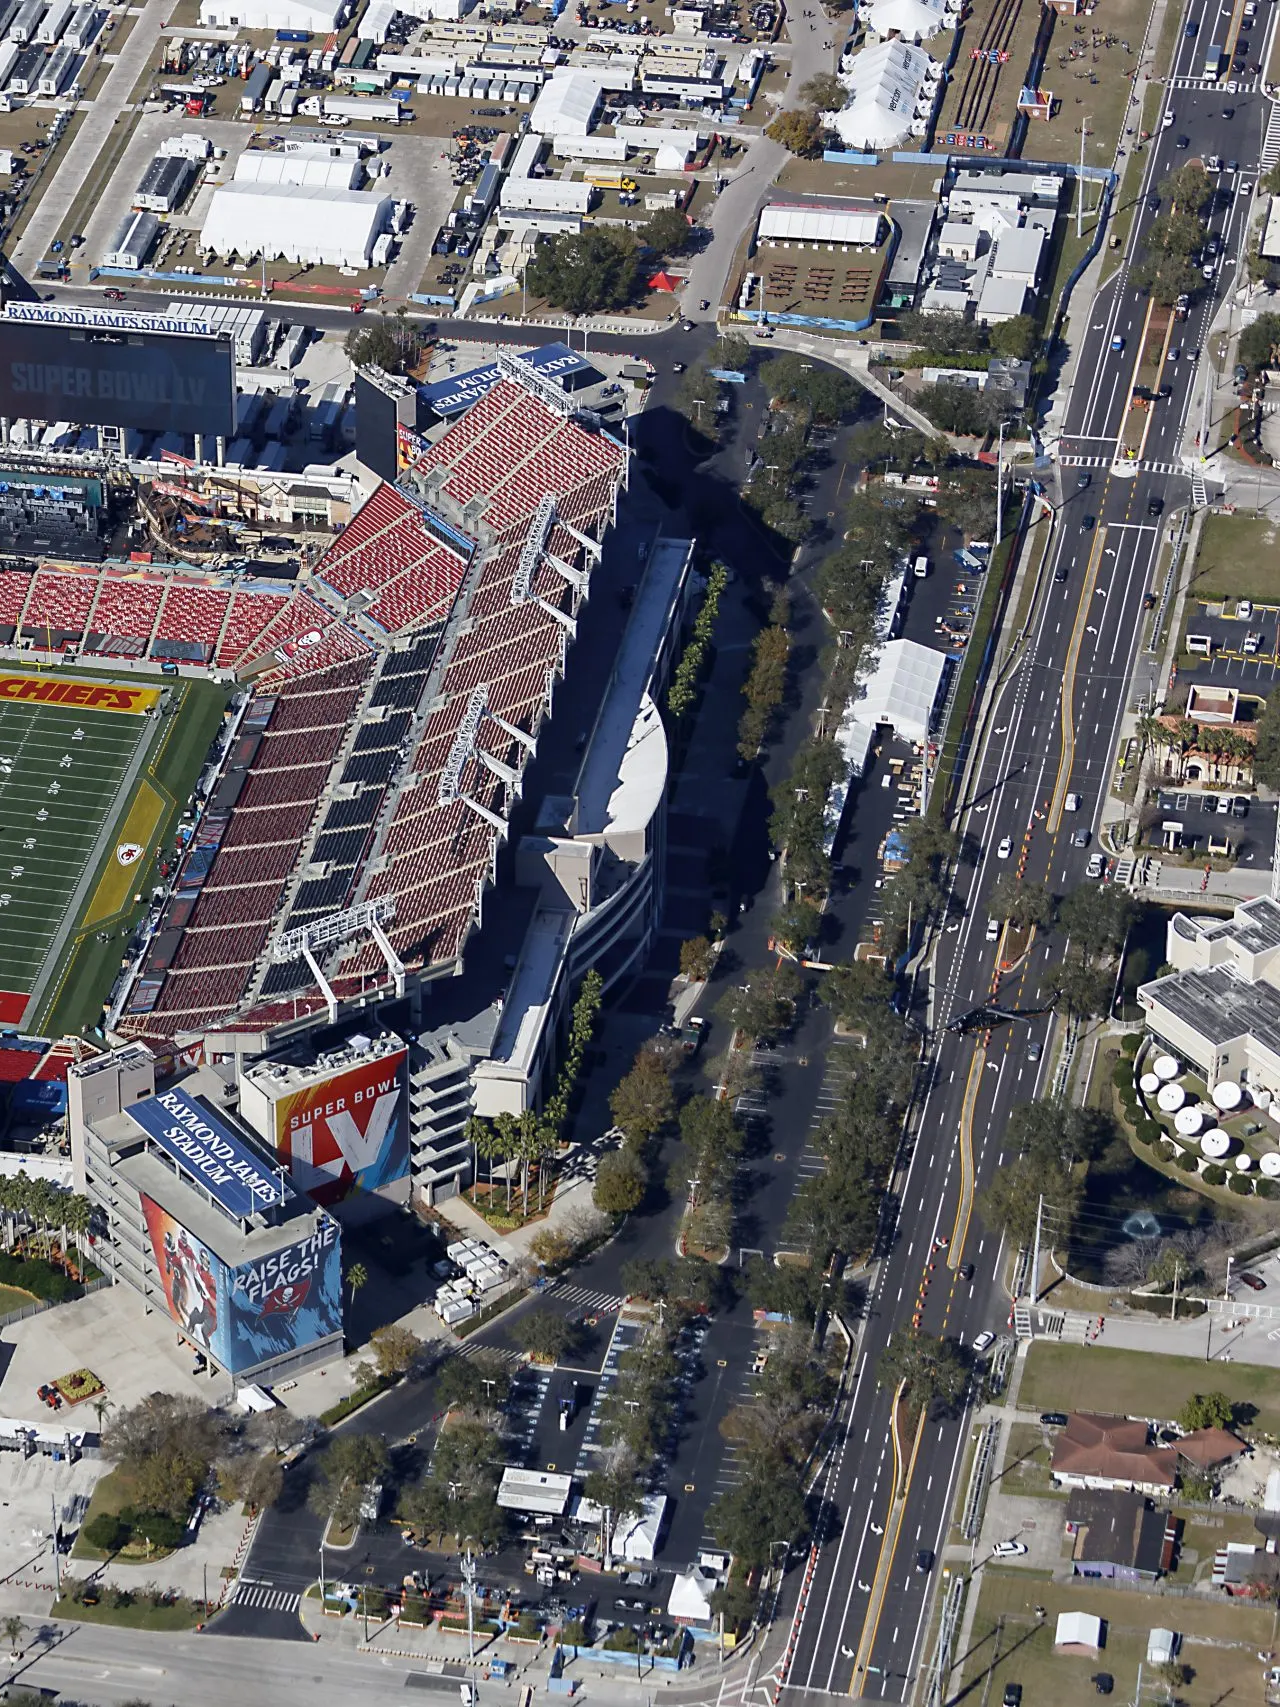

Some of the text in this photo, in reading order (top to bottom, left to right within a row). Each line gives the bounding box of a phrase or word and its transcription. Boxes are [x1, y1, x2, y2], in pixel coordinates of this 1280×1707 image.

[888, 88, 902, 112] verizon
[8, 307, 208, 334] RAYMOND JAMES STADIUM
[10, 362, 92, 398] SUPER
[98, 369, 173, 402] BOWL
[434, 383, 489, 409] JAMES
[399, 429, 422, 447] SUPER
[71, 730, 85, 741] 10
[59, 756, 73, 768] 20
[47, 782, 61, 795] 30
[35, 810, 49, 822] 40
[23, 838, 37, 850] 50
[11, 865, 25, 879] 40
[290, 1077, 401, 1129] SUPER BOWL
[156, 1092, 282, 1203] RAYMOND JAMES
[290, 1089, 401, 1193] LV
[163, 1127, 234, 1185] STADIUM
[233, 1226, 336, 1300] RAISE THE
[249, 1253, 320, 1303] FLAGS!
